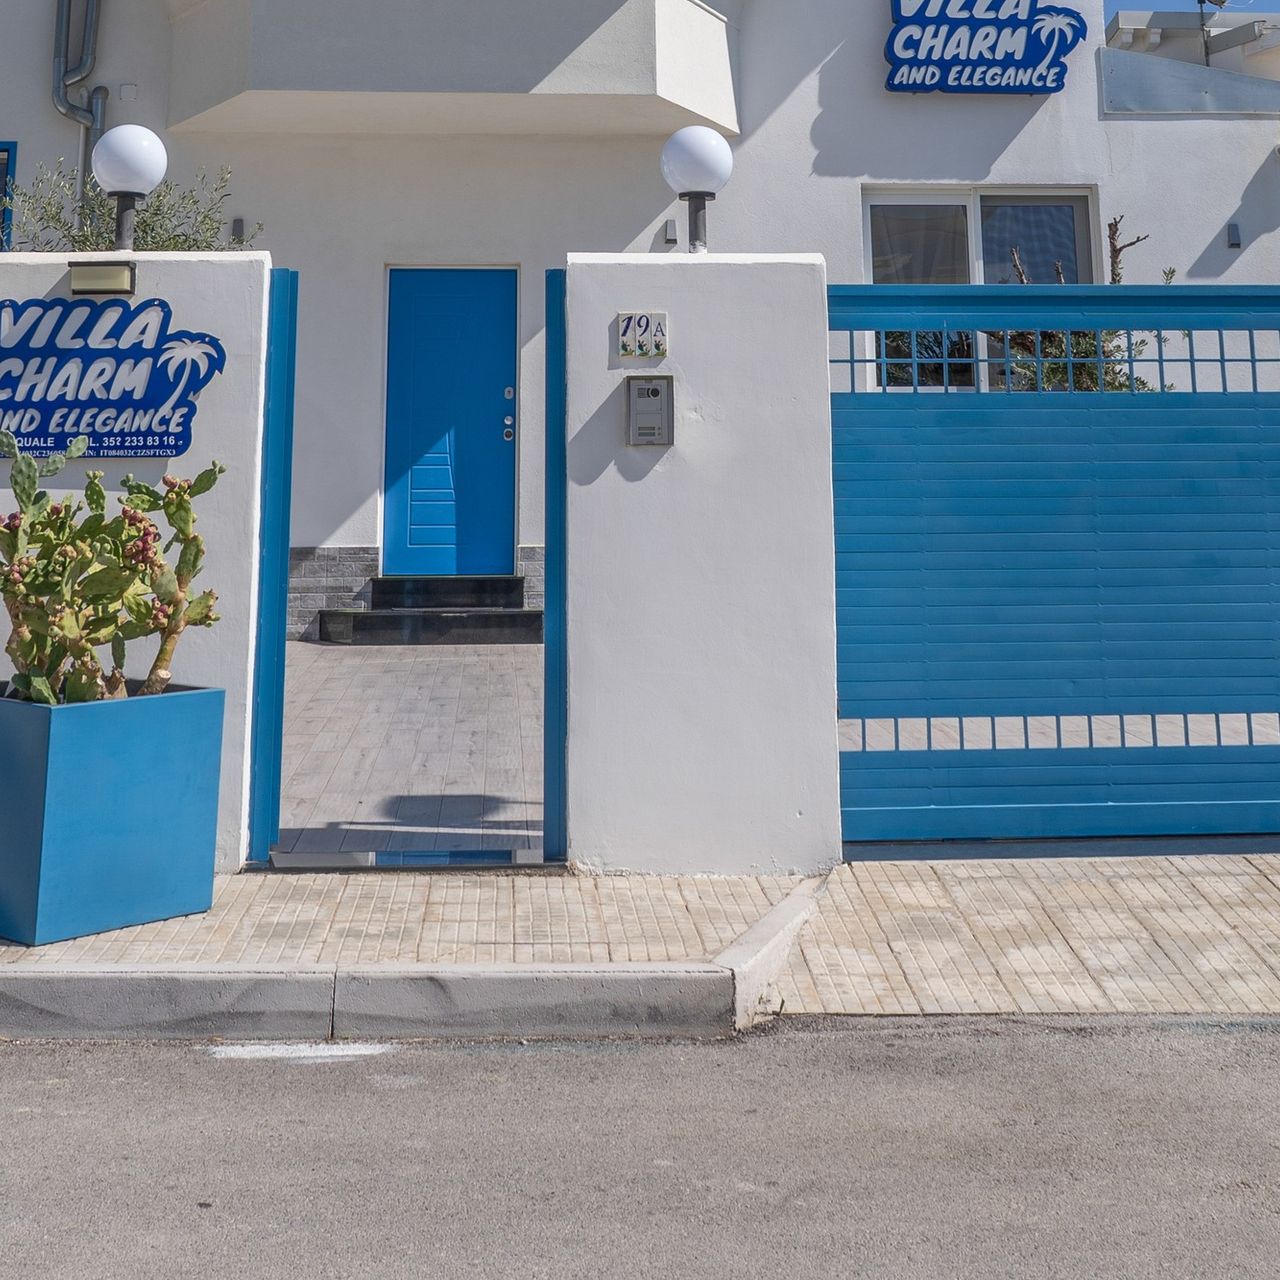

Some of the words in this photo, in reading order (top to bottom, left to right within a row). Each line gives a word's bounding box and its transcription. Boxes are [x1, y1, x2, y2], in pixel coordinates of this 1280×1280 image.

[893, 24, 1029, 61] CHARM
[893, 64, 941, 85] AND
[947, 65, 1061, 87] ELEGANCE
[0, 306, 164, 350] VILLA
[48, 407, 189, 434] ELEGANCE
[124, 436, 143, 446] 233
[146, 436, 160, 446] 83
[163, 435, 175, 445] 16
